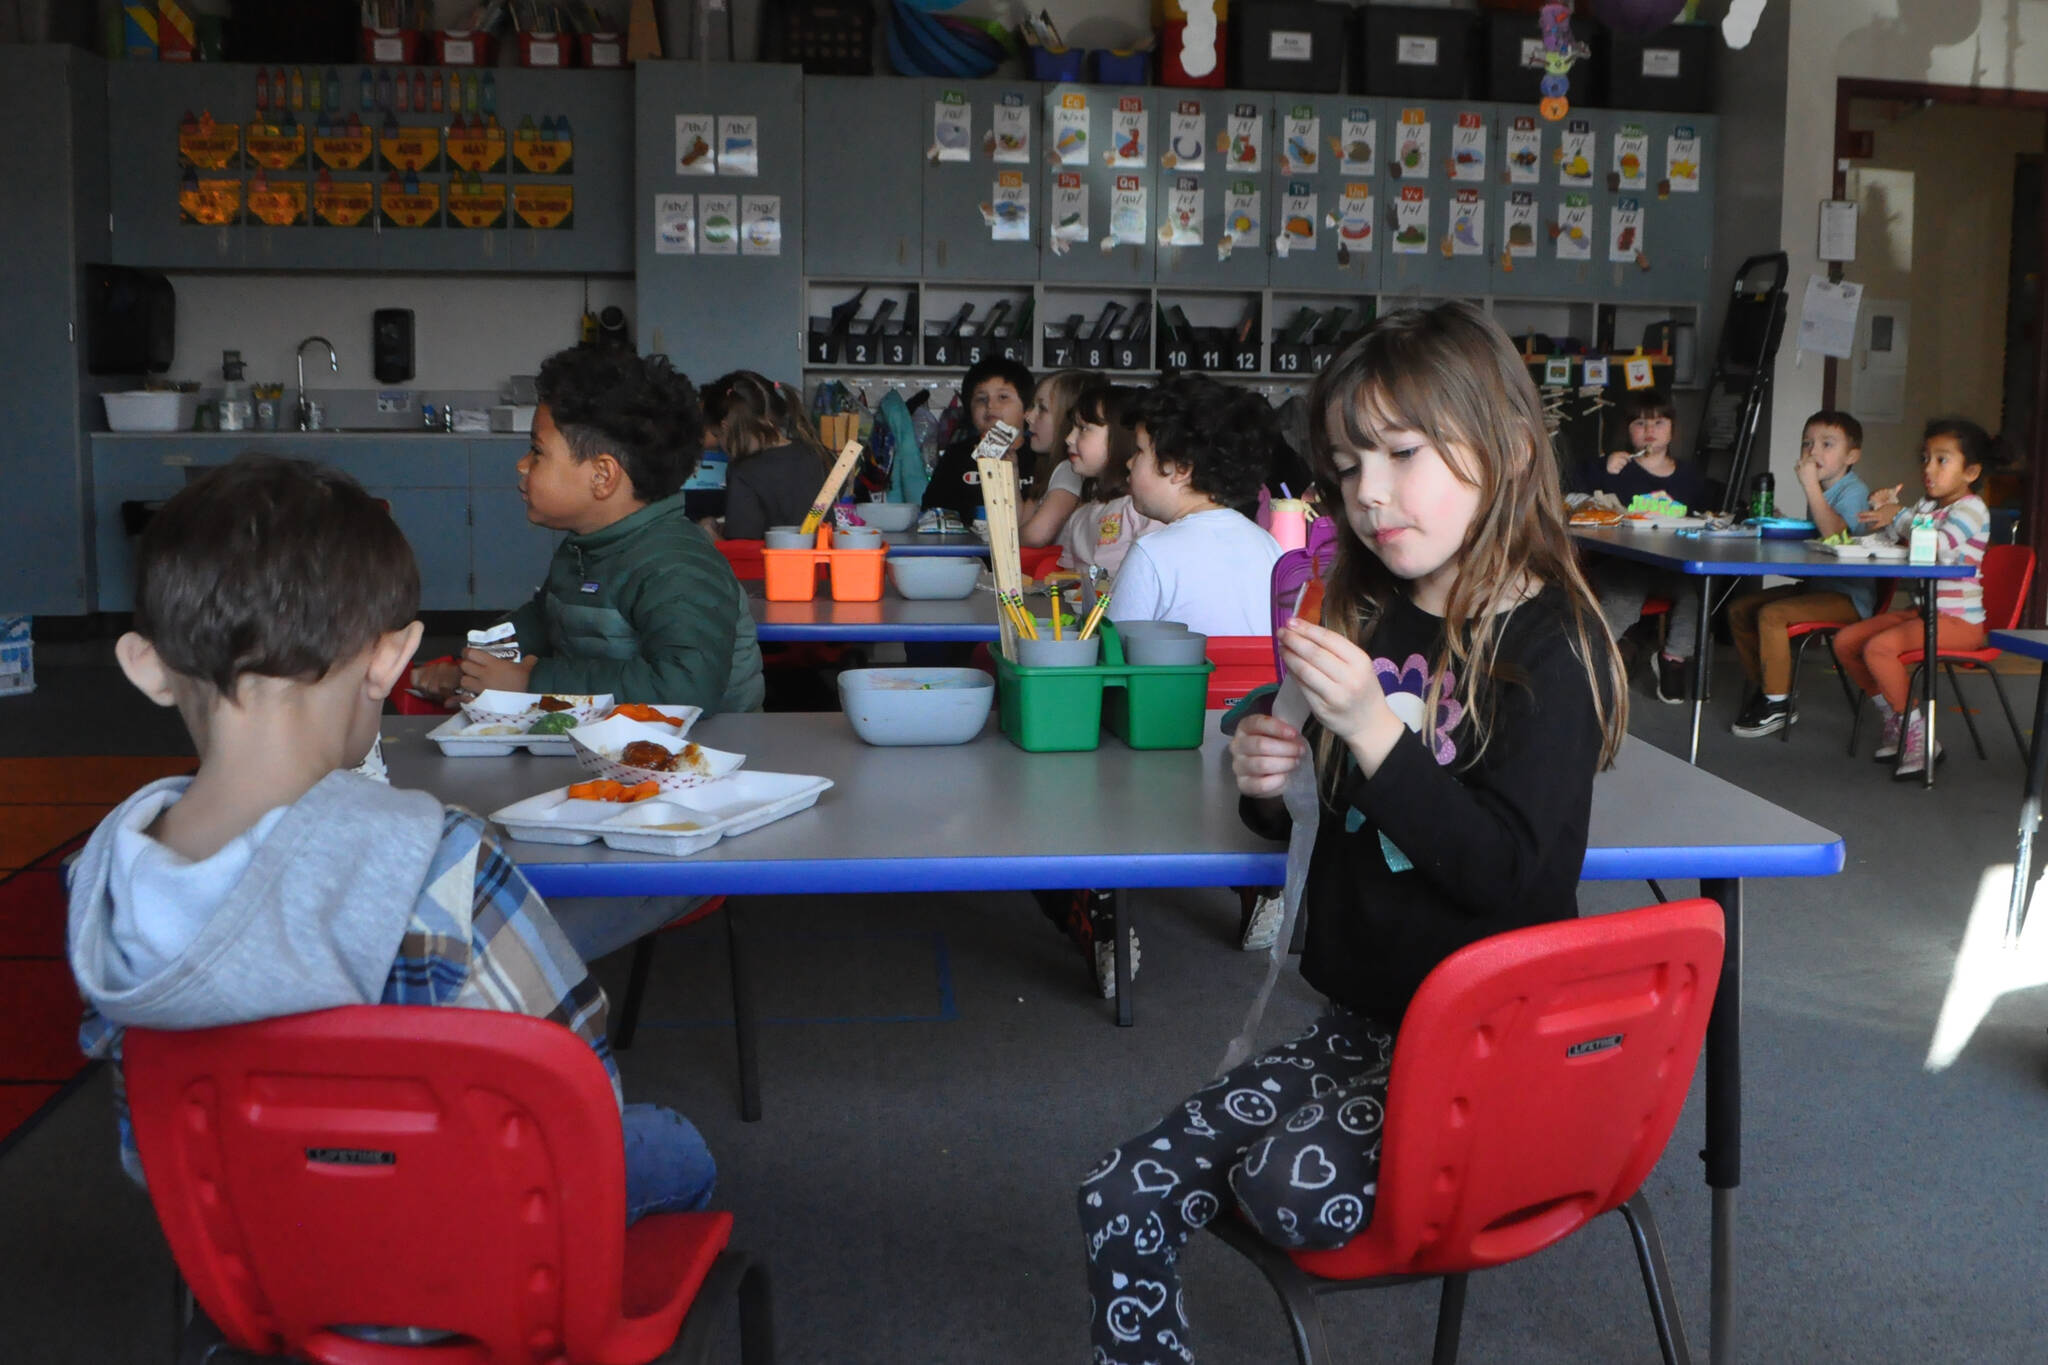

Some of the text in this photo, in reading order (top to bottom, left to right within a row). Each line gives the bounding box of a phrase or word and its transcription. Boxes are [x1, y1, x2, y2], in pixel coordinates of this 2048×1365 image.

[1181, 102, 1199, 114] Ee
[681, 120, 708, 133] /th/
[726, 121, 752, 135] /th/
[462, 142, 488, 155] MAY
[1119, 178, 1137, 190] Qq
[1179, 179, 1195, 191] Rr
[1404, 189, 1421, 200] Vv
[818, 342, 828, 360] 1
[856, 345, 866, 362] 2
[893, 345, 903, 362] 3
[935, 346, 946, 363] 4
[970, 347, 980, 364] 5
[1004, 347, 1014, 360] 6
[1055, 349, 1066, 365] 7
[1090, 351, 1100, 366] 8
[1122, 350, 1133, 367] 9
[1168, 351, 1188, 368] 10
[1203, 351, 1220, 368] 11
[1235, 352, 1255, 370] 12
[1278, 353, 1297, 370] 13
